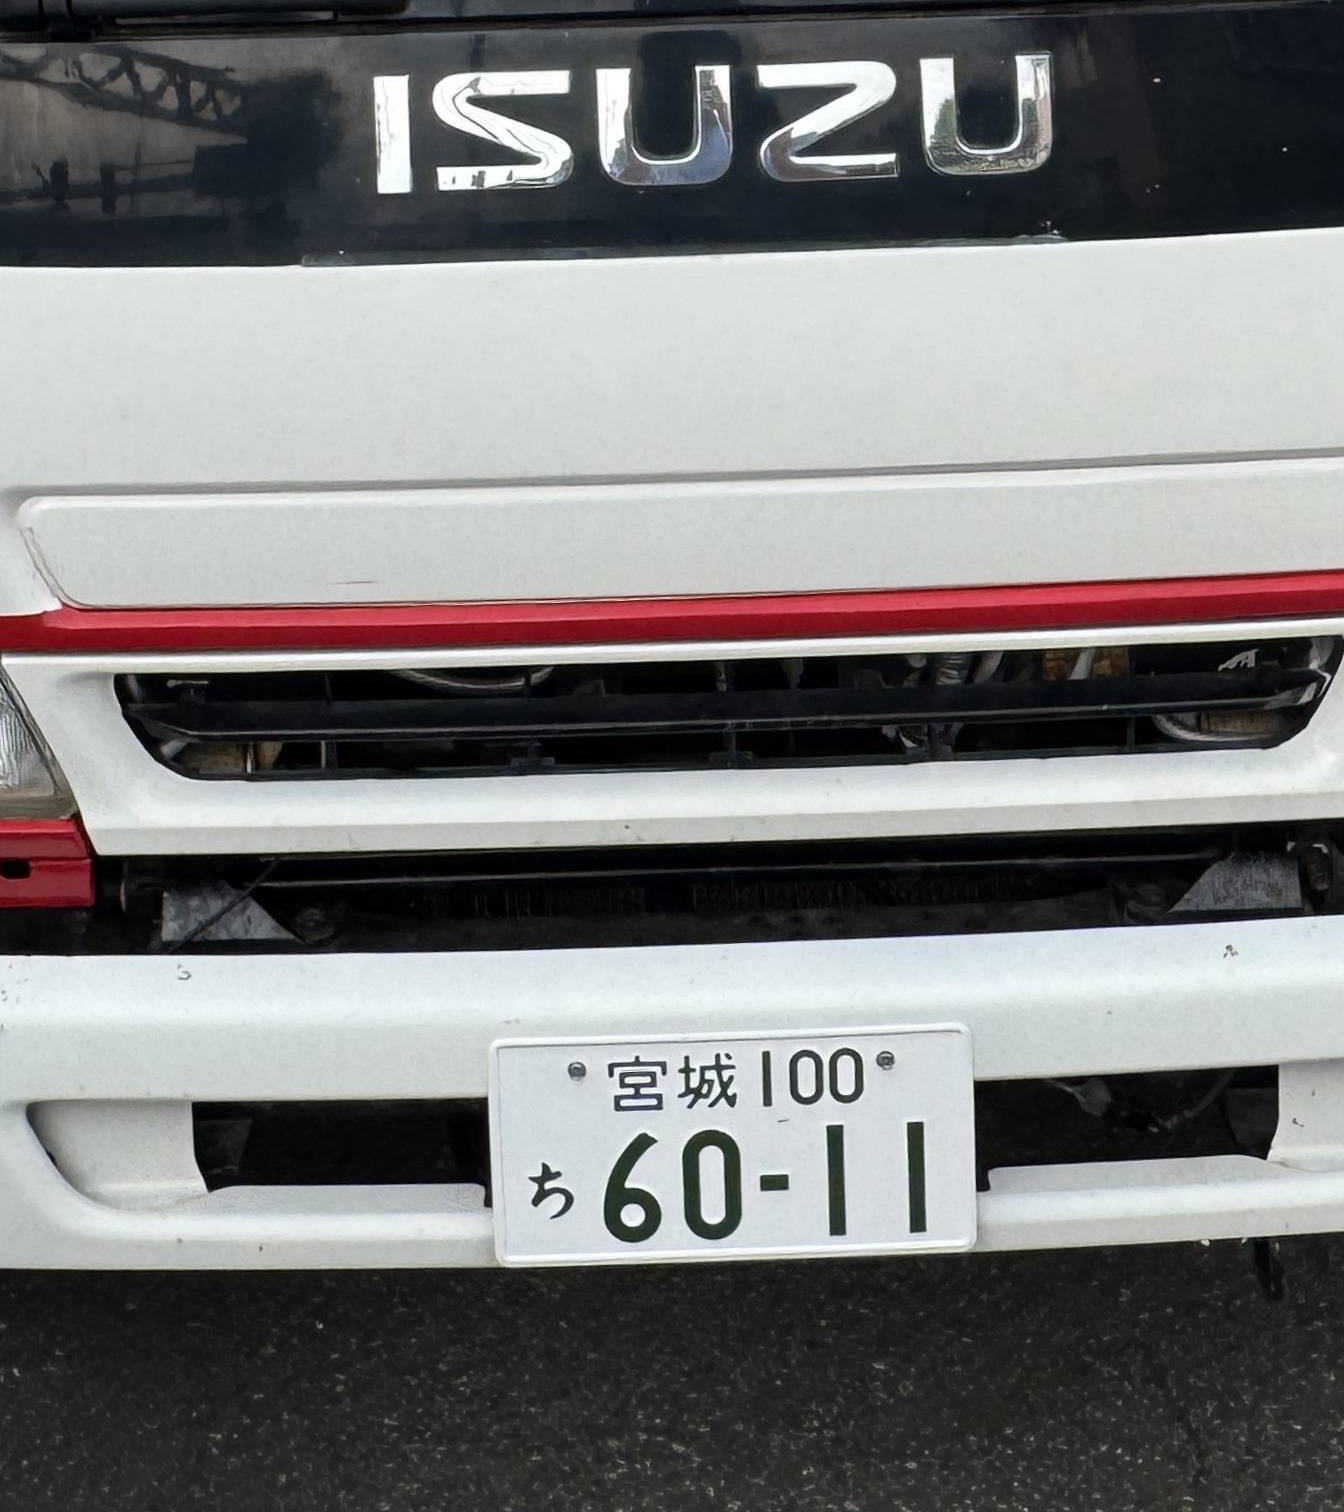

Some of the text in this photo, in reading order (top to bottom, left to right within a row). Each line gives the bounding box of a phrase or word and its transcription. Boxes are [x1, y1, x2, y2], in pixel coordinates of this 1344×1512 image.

[372, 50, 1054, 194] ISUZU
[607, 1047, 864, 1112] 宮城 100
[528, 1121, 927, 1243] ち 60-11
